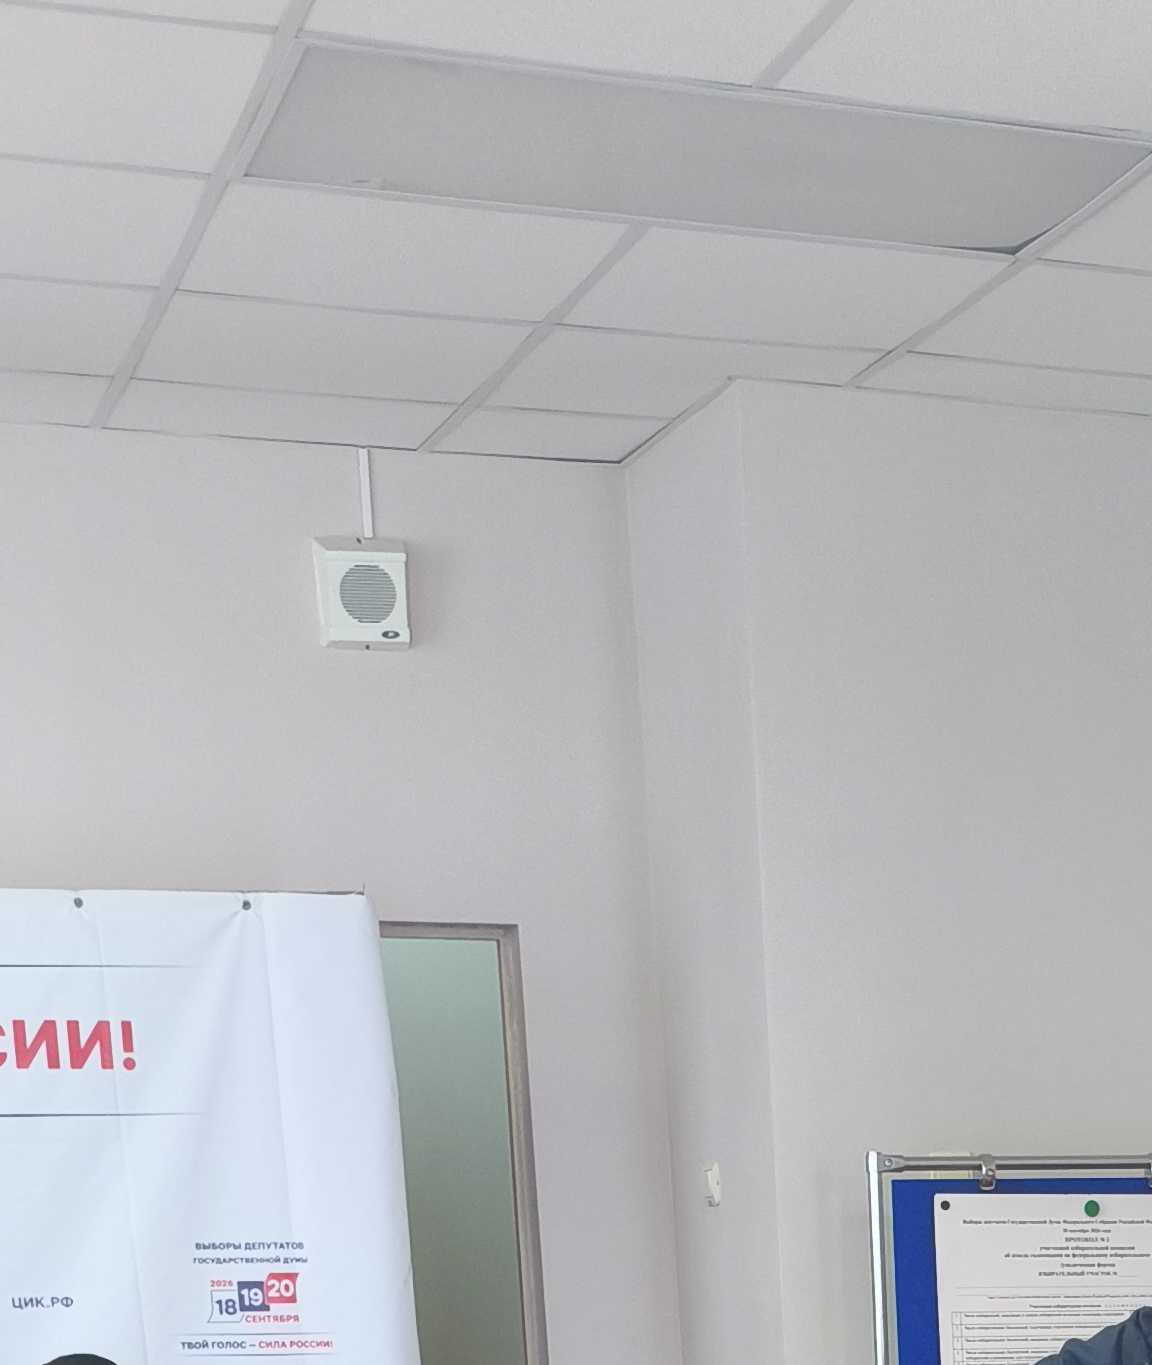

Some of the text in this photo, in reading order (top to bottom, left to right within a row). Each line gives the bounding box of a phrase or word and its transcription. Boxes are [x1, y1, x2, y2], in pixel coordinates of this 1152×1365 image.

[0, 1019, 136, 1071] ИИ!
[195, 1242, 304, 1251] ВЫБОРЫ ДЕПУТАТОВ
[193, 1256, 281, 1264] ГОСУДАРСТВЕННОЙ
[215, 1279, 294, 1315] 18 19 20
[12, 1296, 74, 1309] ЦИК.РФ
[245, 1315, 299, 1323] СЕНТЯБРЯ
[181, 1340, 209, 1349] ТВОЙ
[212, 1341, 246, 1349] ГОЛОС
[290, 1340, 333, 1348] РОССИИ!
